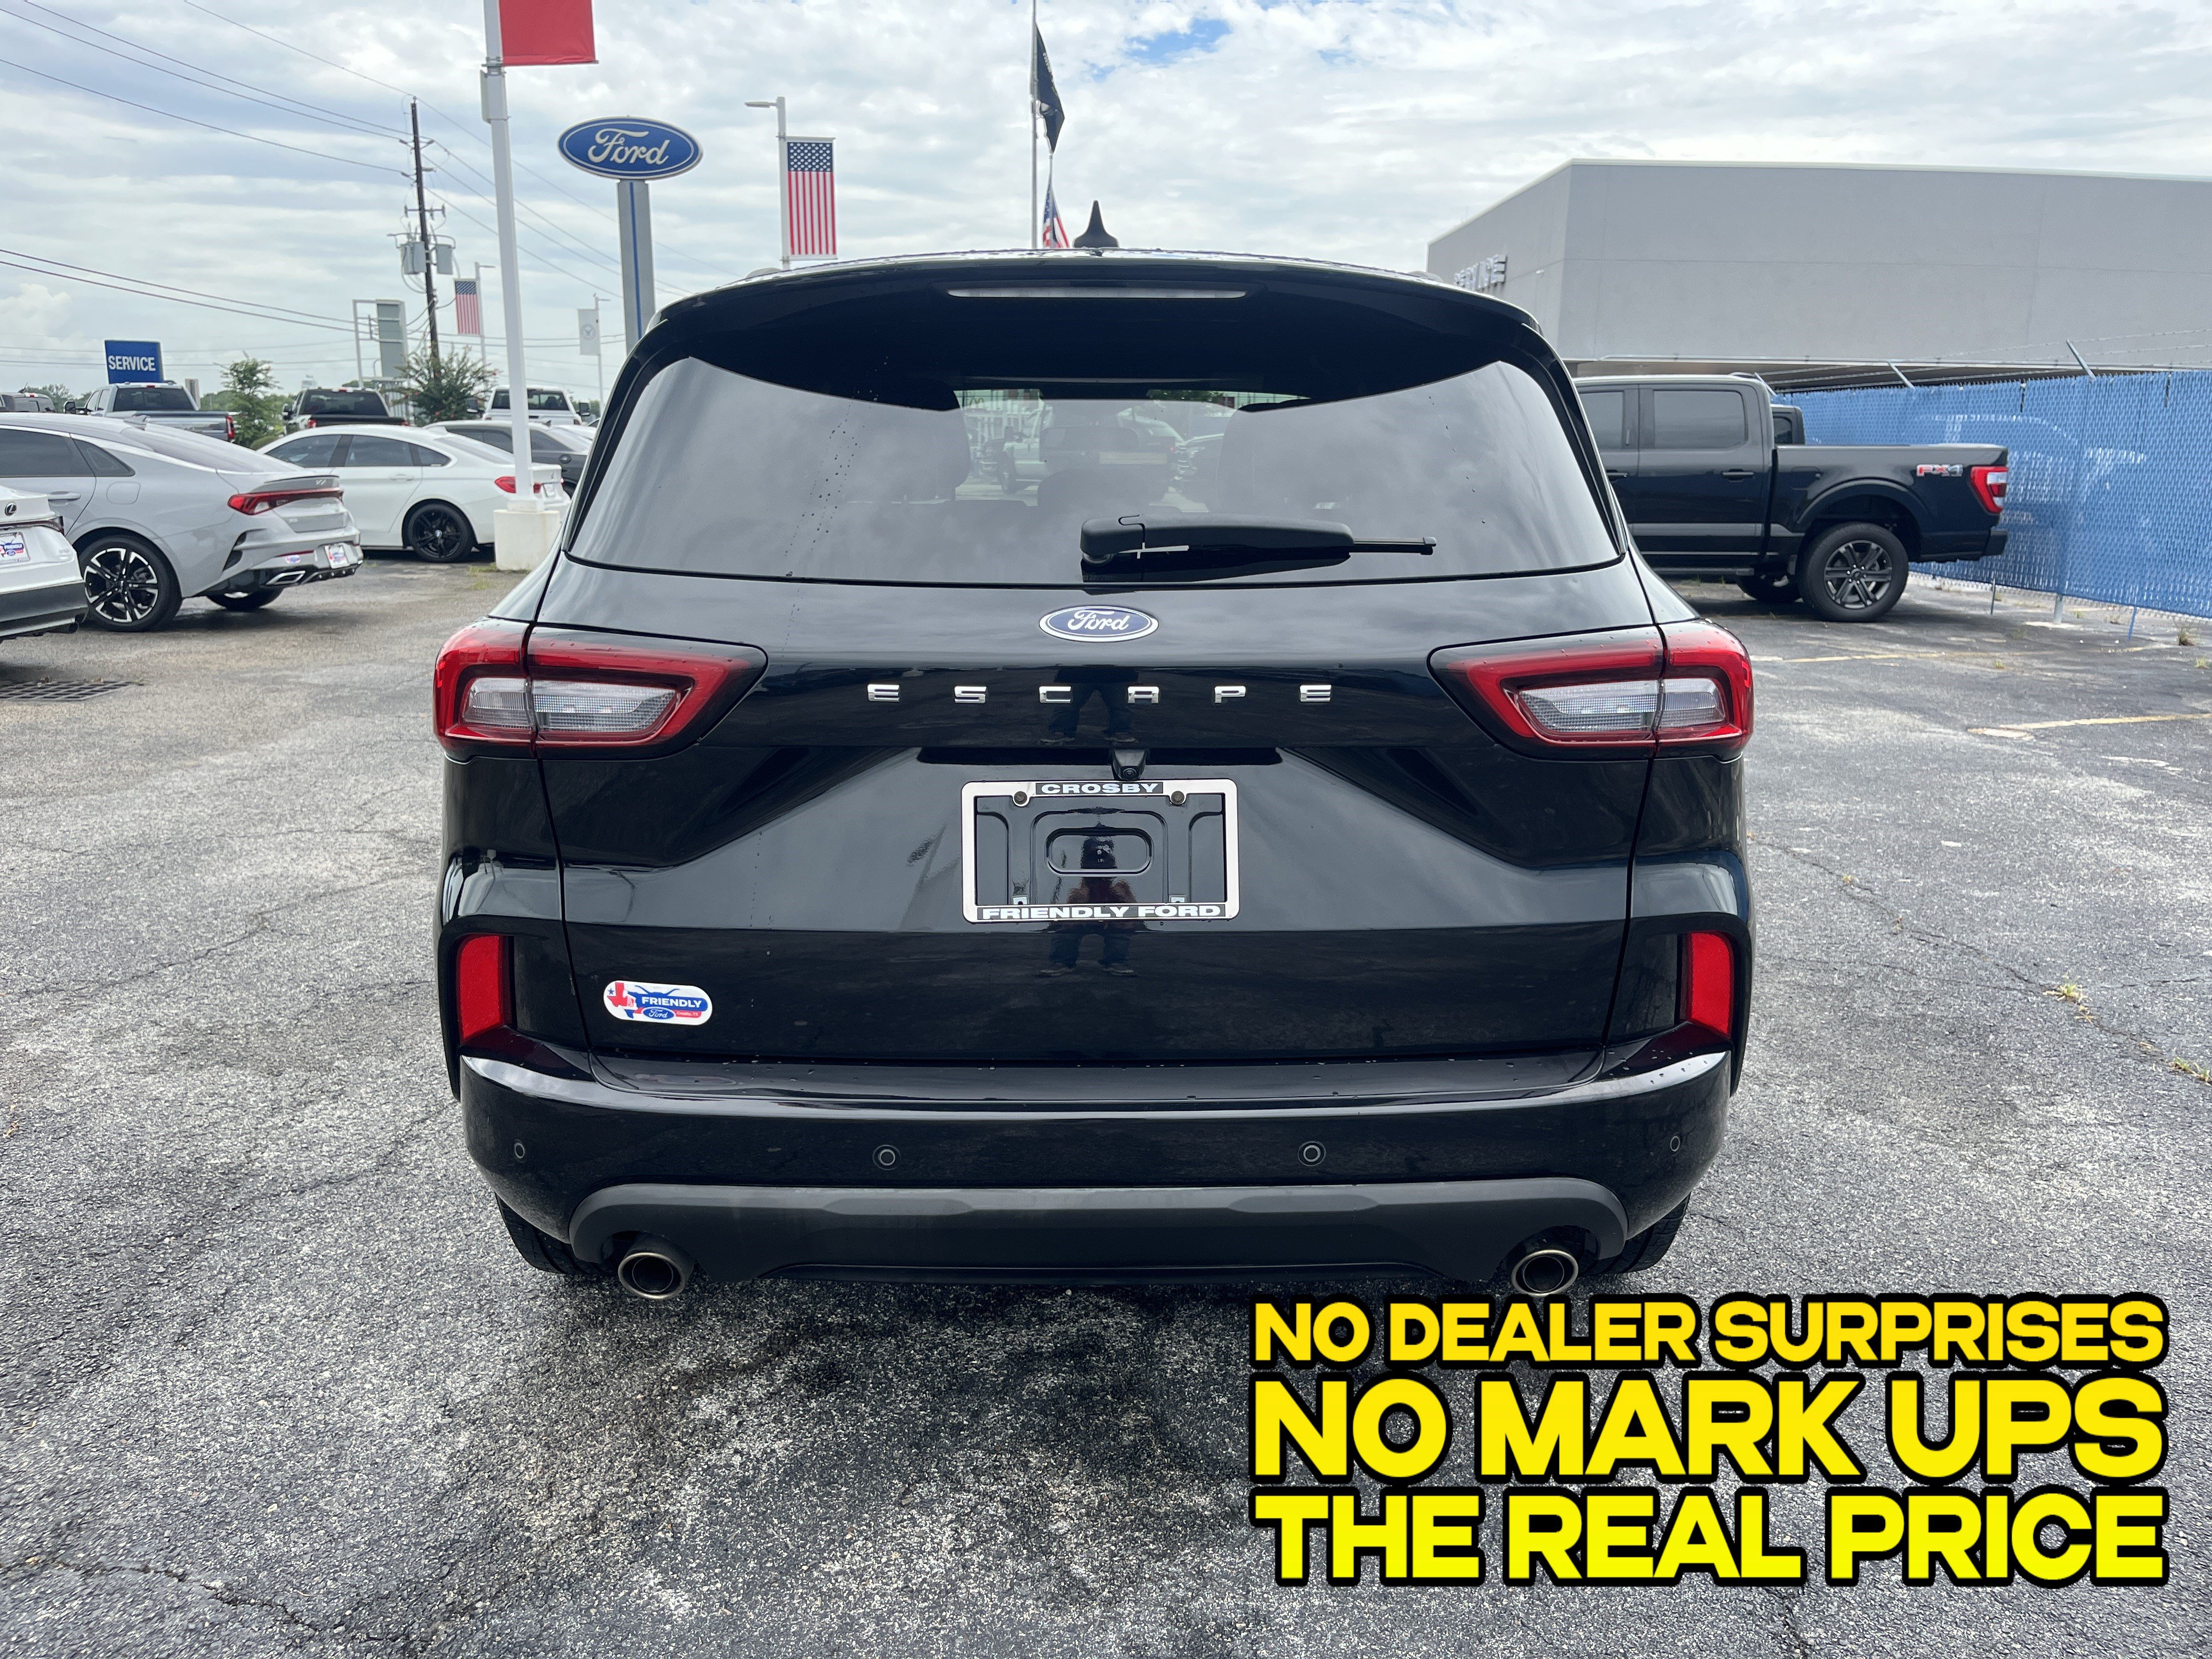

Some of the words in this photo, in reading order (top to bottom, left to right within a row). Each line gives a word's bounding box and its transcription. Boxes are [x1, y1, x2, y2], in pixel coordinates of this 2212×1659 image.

[588, 128, 671, 165] Ford
[108, 354, 156, 371] SERVICE
[1916, 464, 1963, 477] FX4
[1067, 610, 1131, 630] Ford
[866, 684, 1332, 704] ESCAPE
[1041, 783, 1159, 794] CROSBY
[982, 906, 1131, 919] FRIENDLY
[1137, 905, 1221, 918] FORD
[641, 996, 702, 1008] FRIENDLY
[648, 1009, 669, 1018] Ford
